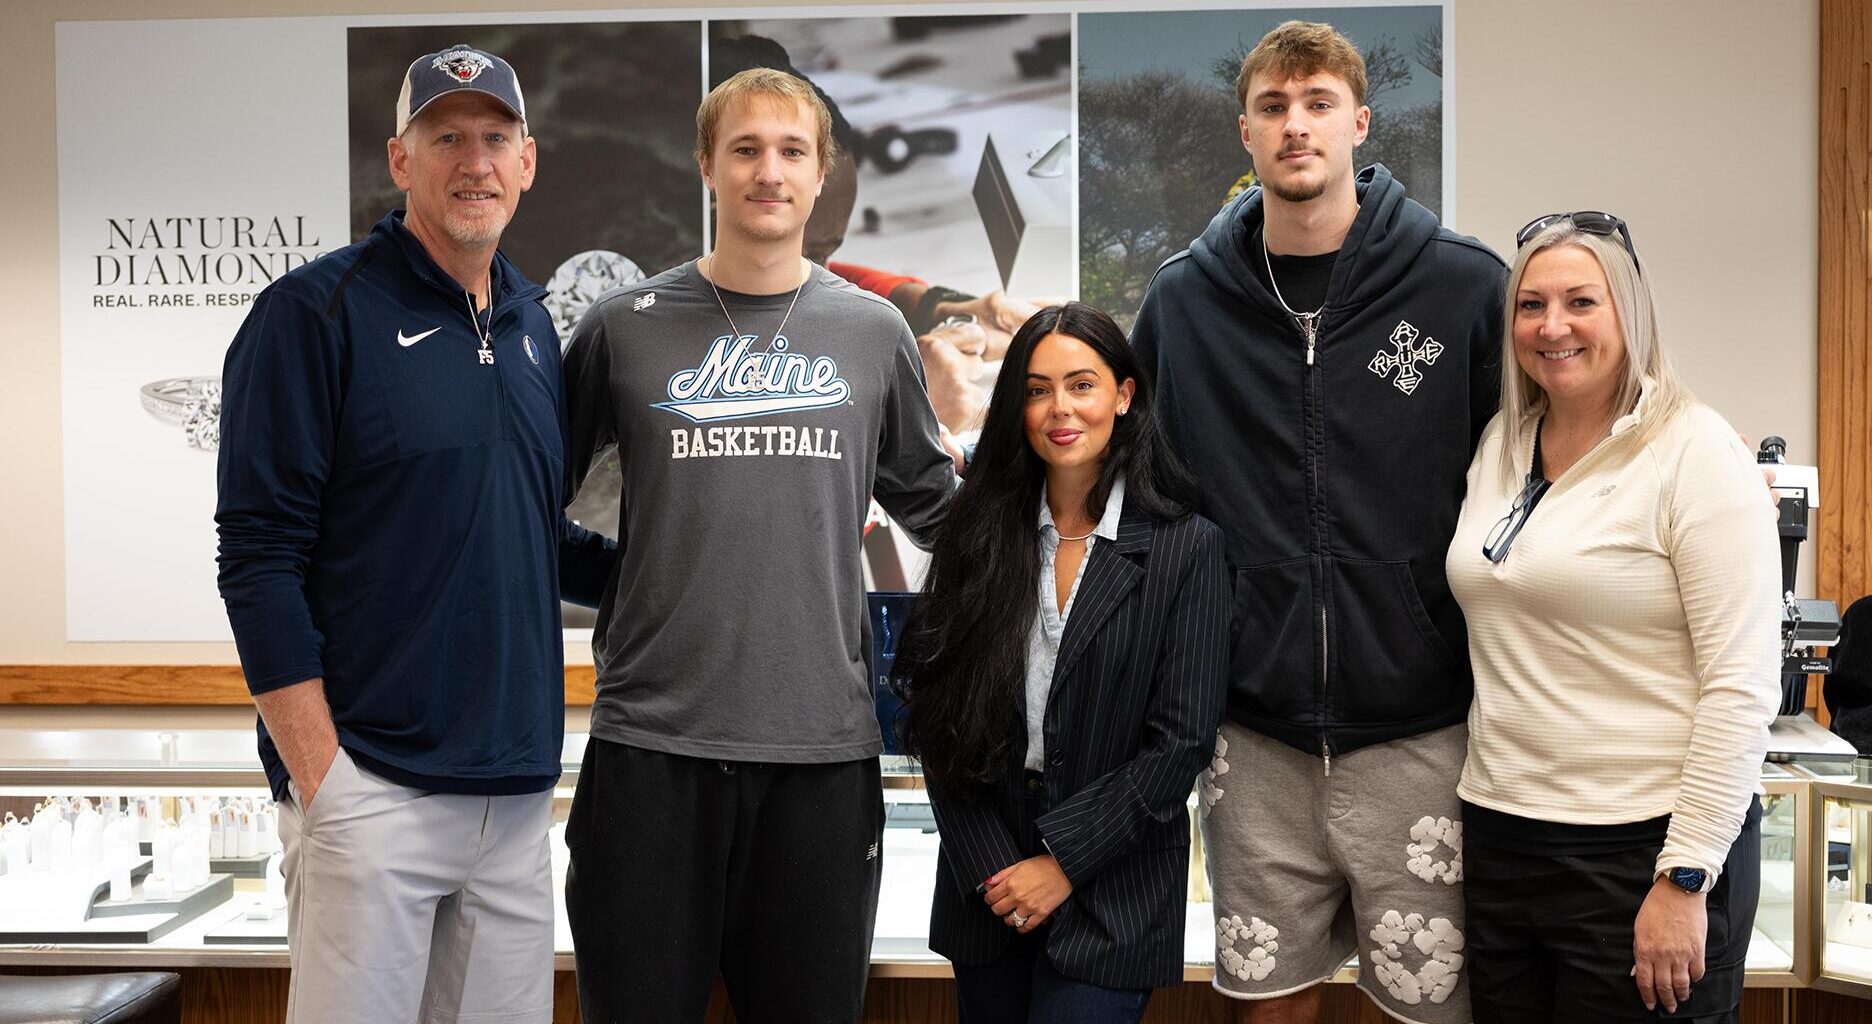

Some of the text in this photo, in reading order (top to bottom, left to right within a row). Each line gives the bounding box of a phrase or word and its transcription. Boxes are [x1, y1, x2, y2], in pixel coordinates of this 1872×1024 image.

[106, 215, 320, 249] NATURAL
[94, 251, 328, 286] DIAMOND
[94, 294, 143, 307] REAL.
[148, 293, 200, 307] RARE.
[668, 334, 850, 401] Maine
[671, 426, 842, 459] BASKETBALL
